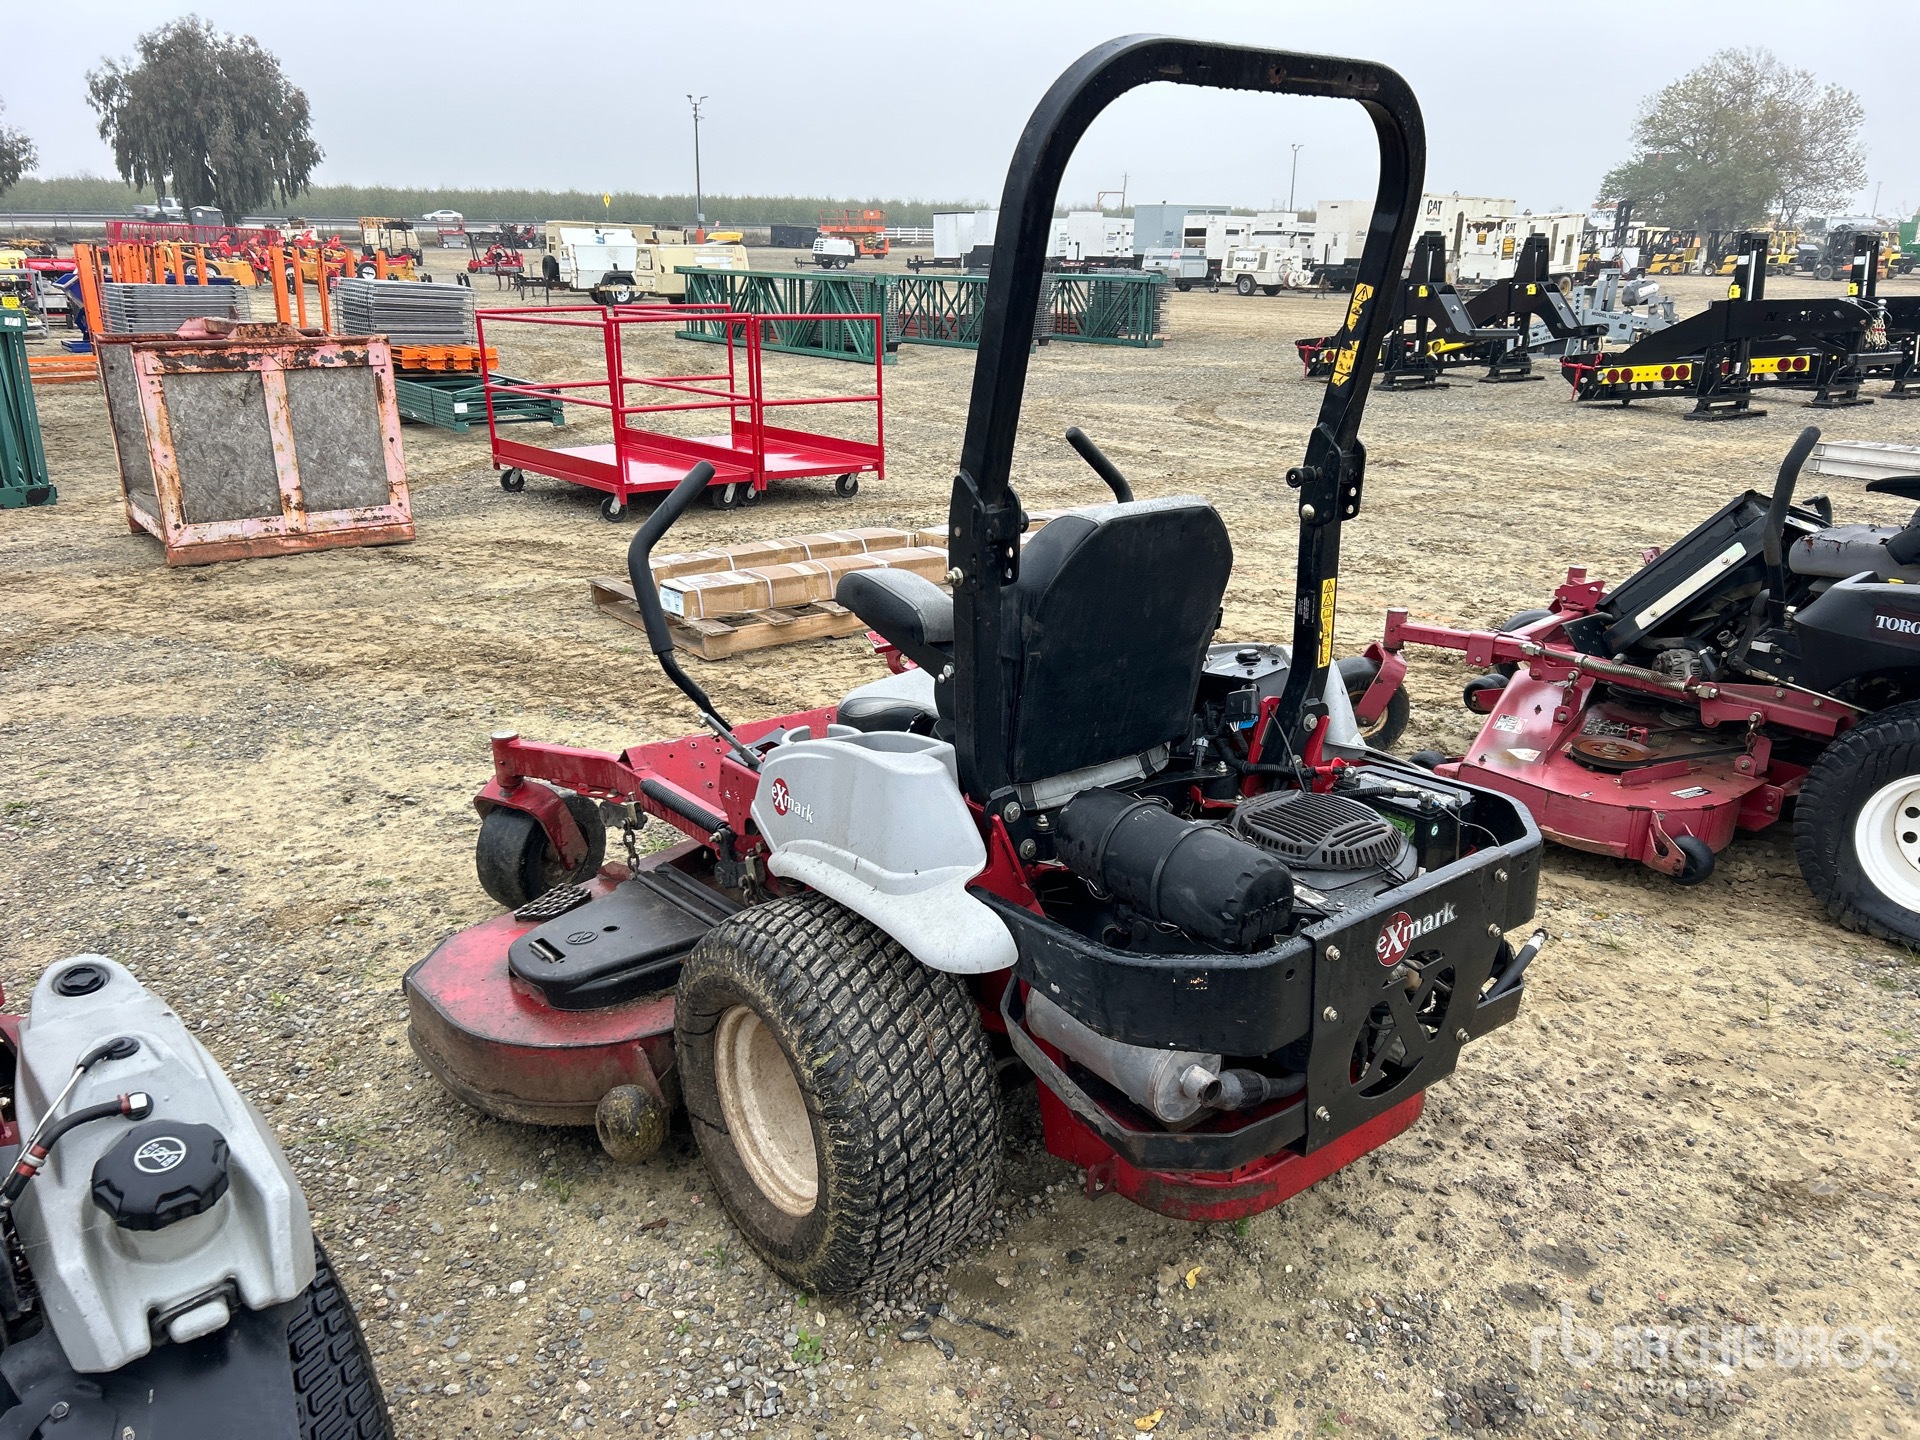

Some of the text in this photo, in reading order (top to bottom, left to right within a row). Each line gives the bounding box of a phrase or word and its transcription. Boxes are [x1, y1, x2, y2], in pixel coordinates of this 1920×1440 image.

[1427, 199, 1443, 216] CAT
[1505, 222, 1517, 234] CAT
[1591, 311, 1607, 319] MODEL
[1875, 614, 1920, 635] TORO
